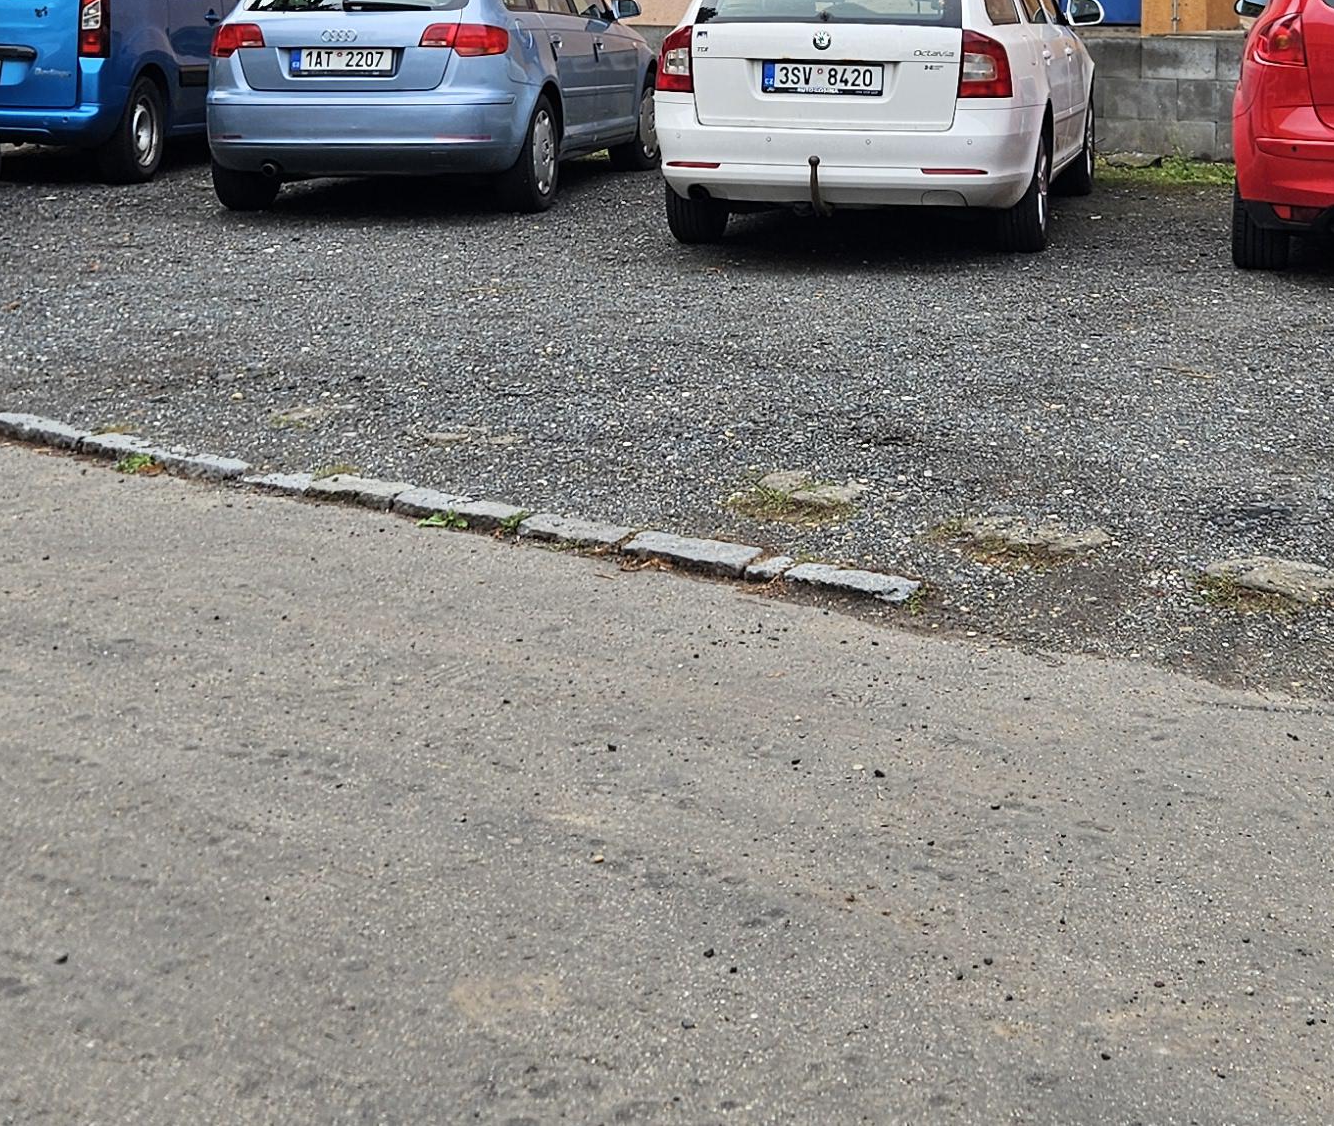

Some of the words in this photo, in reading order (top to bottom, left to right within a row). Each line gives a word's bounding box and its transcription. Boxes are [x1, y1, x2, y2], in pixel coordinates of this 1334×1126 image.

[306, 51, 333, 67] 1AT
[345, 51, 384, 67] 2207
[779, 66, 812, 86] 3SV
[827, 68, 872, 87] 8420
